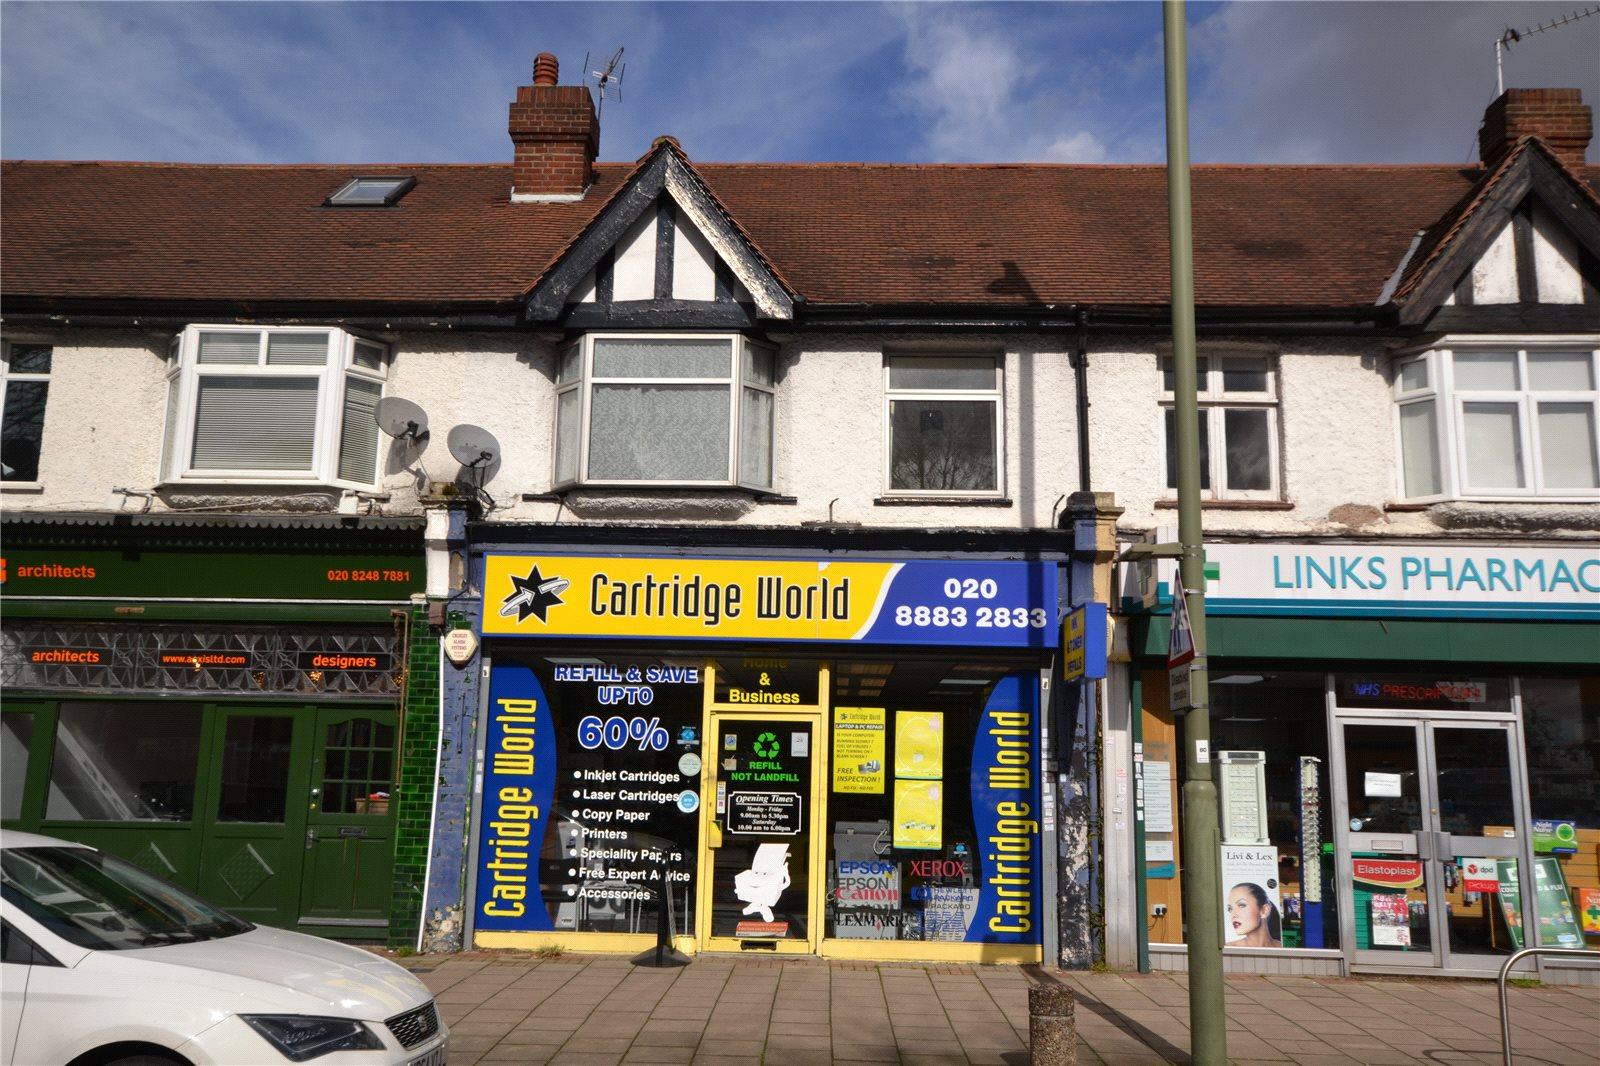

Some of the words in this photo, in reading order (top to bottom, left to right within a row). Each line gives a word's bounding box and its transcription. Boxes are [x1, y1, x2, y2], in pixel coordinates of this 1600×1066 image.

[18, 564, 97, 578] architects
[327, 570, 349, 581] 020
[351, 570, 380, 581] 8248
[382, 571, 411, 582] 7881
[1273, 555, 1387, 590] LINKS
[1401, 557, 1600, 592] PHARMAC
[943, 578, 998, 600] 020
[590, 573, 741, 626] Cartridge
[756, 576, 850, 621] World
[895, 605, 968, 627] 8883
[975, 607, 1047, 628] 2833
[31, 650, 100, 663] architects
[312, 655, 377, 669] designers
[554, 664, 622, 682] REFILL
[626, 665, 642, 682] &
[646, 665, 699, 683] SAVE
[759, 672, 771, 686] &
[597, 686, 654, 705] UPTO
[729, 689, 800, 704] Business
[1353, 683, 1381, 696] NHS
[493, 698, 537, 776] World
[577, 715, 669, 751] 60%
[988, 711, 1031, 789] World
[749, 761, 782, 770] REFILL
[584, 769, 617, 783] Inkjet
[619, 770, 680, 784] Cartridges
[731, 772, 752, 781] NOT
[754, 773, 799, 782] LANDFILL
[583, 789, 616, 800] Laser
[619, 790, 680, 804] Cartridges
[735, 794, 769, 803] Opening
[770, 794, 794, 803] Times
[582, 808, 613, 822] Copy
[615, 809, 651, 823] Paper
[581, 828, 628, 839] Printers
[484, 787, 539, 917] Cartridge
[580, 847, 638, 863] Speciality
[641, 849, 682, 863] Paprs
[1226, 852, 1243, 860] Livi
[1245, 852, 1254, 860] &
[1256, 852, 1273, 861] Lex
[840, 861, 894, 875] EPSON
[910, 860, 966, 877] XEROX
[988, 800, 1038, 933] Cartridge
[1357, 864, 1417, 876] Elastoplast
[1480, 864, 1494, 873] dpd
[578, 867, 606, 878] Free
[608, 868, 647, 881] Expert
[650, 869, 691, 882] Avice
[578, 887, 651, 900] Accessories
[835, 887, 898, 901] Canon
[836, 912, 905, 928] LEXMARK
